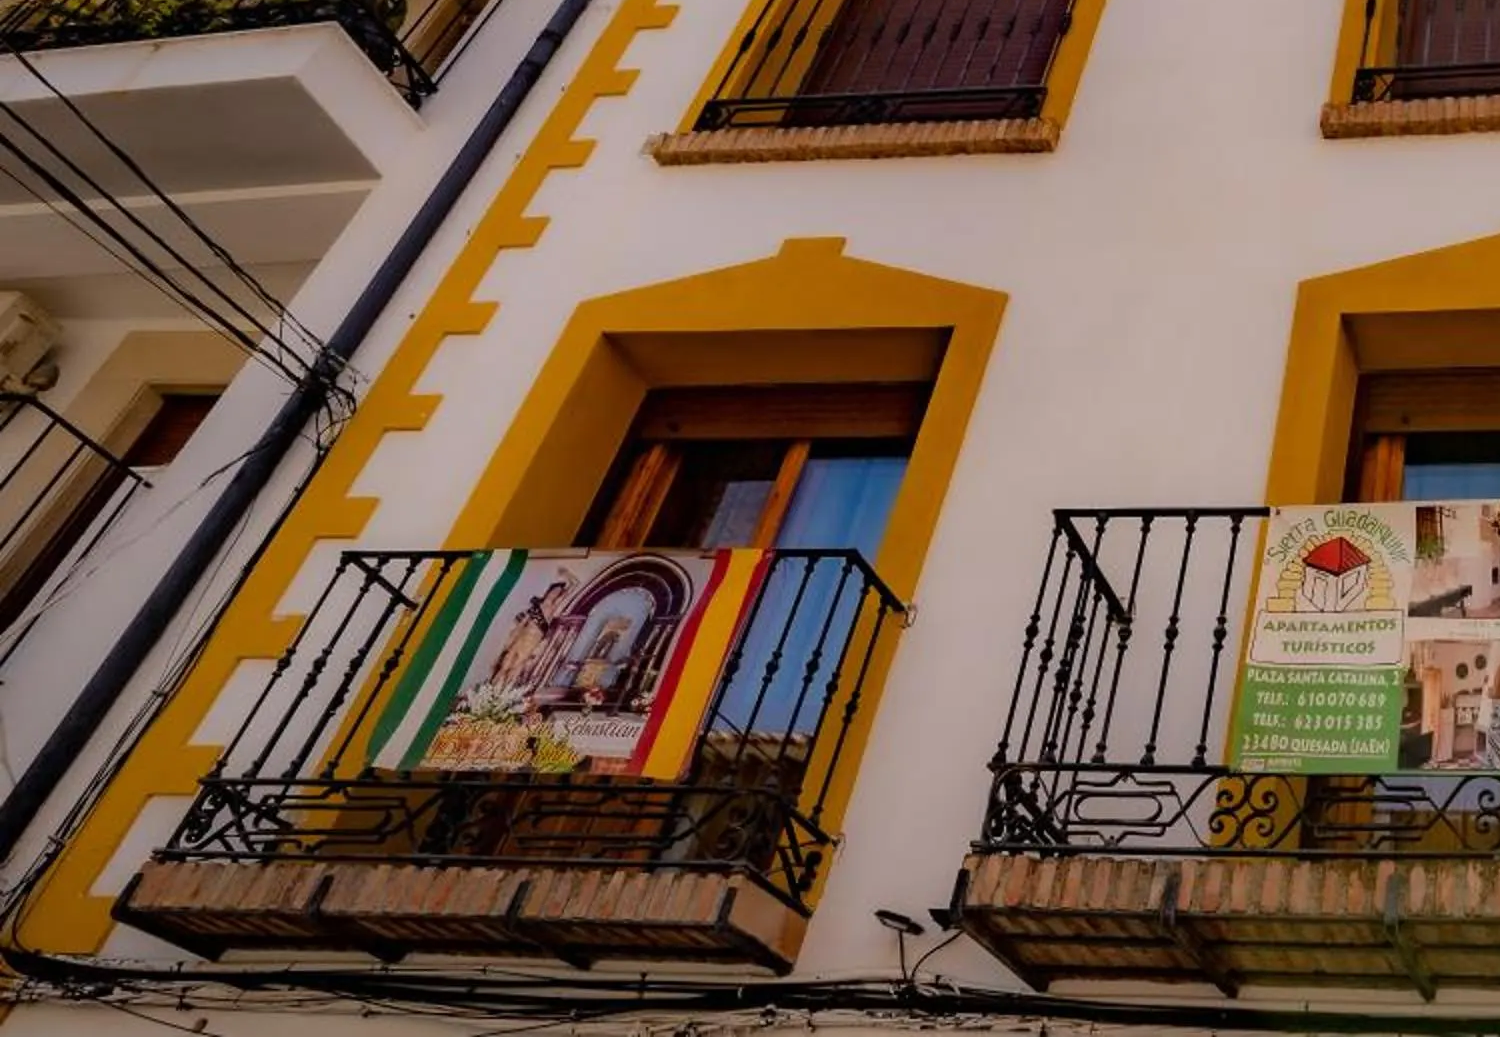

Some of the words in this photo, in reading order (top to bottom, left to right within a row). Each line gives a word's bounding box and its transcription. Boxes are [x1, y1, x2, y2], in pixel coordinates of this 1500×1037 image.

[1263, 618, 1397, 633] APARTAMENTOS
[1281, 638, 1376, 654] TURÍSTICOS
[1247, 669, 1286, 683] PLAZA
[1287, 670, 1325, 684] SANTA
[1328, 671, 1389, 687] CATALINA,
[1253, 712, 1287, 728] TELF.:
[1242, 733, 1289, 751] 23480
[1290, 738, 1347, 753] QUESADA
